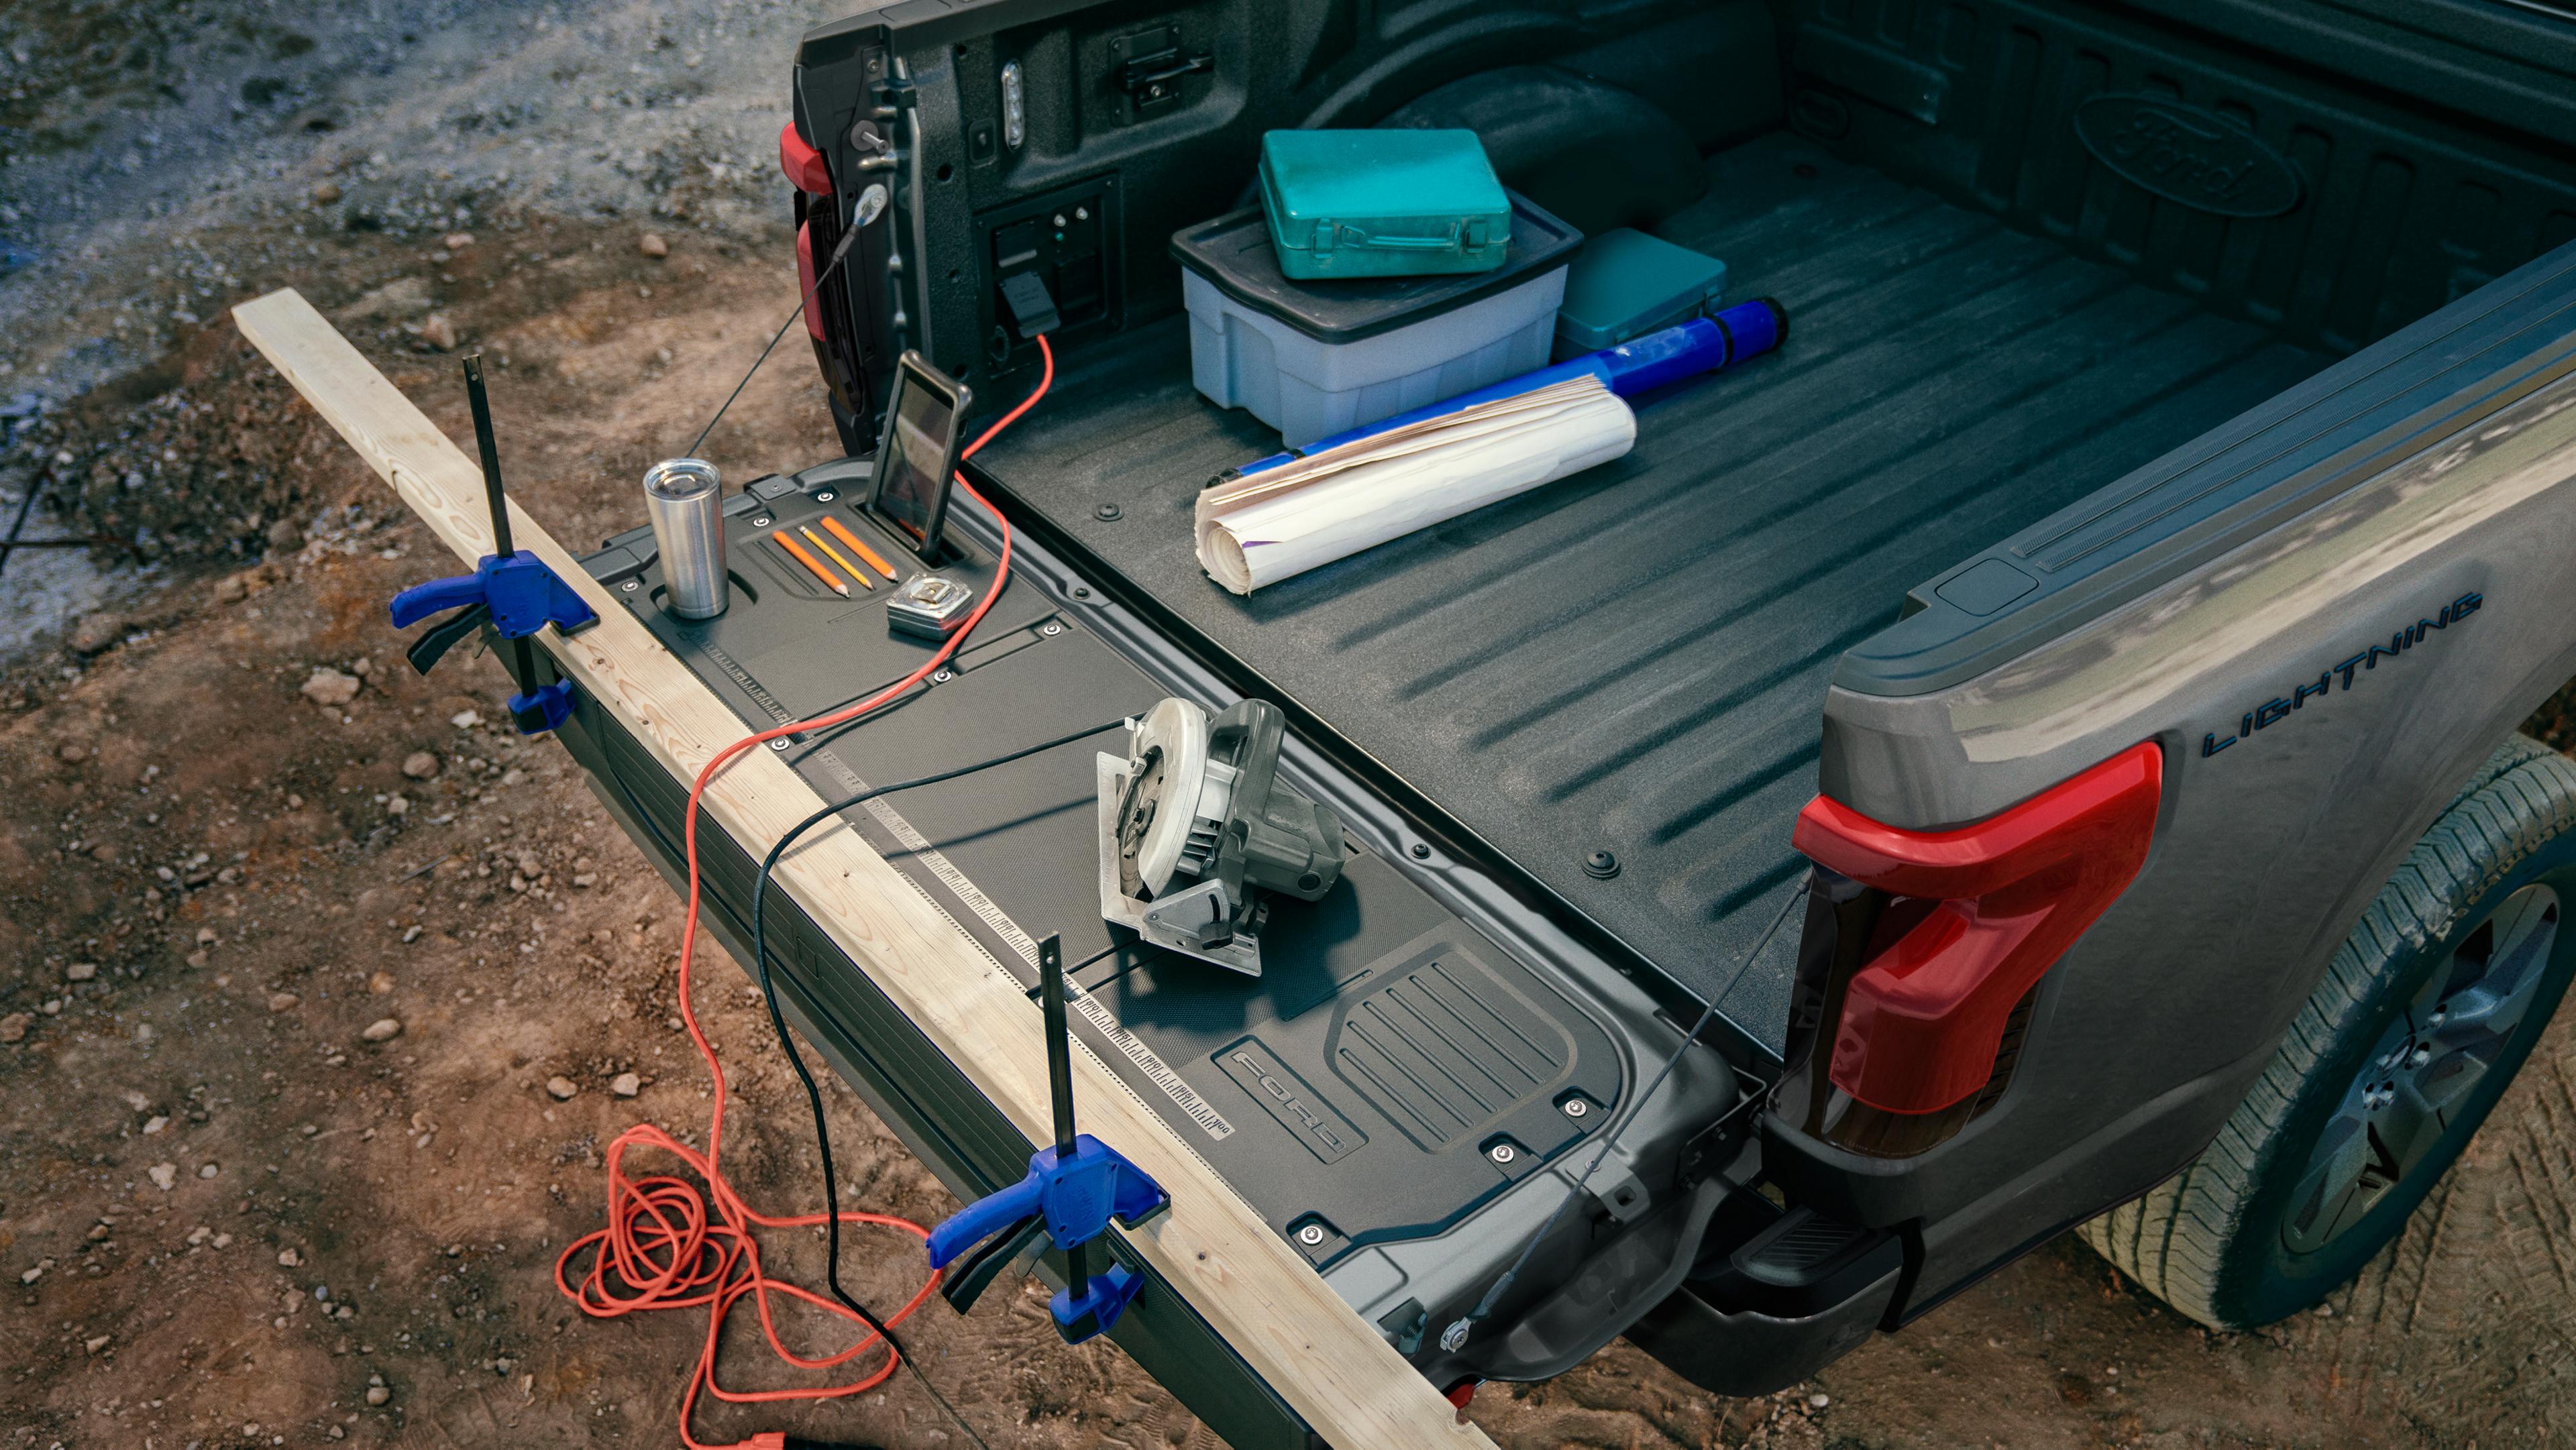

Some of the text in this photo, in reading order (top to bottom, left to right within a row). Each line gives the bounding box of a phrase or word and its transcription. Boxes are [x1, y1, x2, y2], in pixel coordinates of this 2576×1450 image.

[2202, 592, 2483, 759] LIGHTNING
[1213, 1119, 1230, 1133] 100
[1230, 1051, 1346, 1154] FORD
